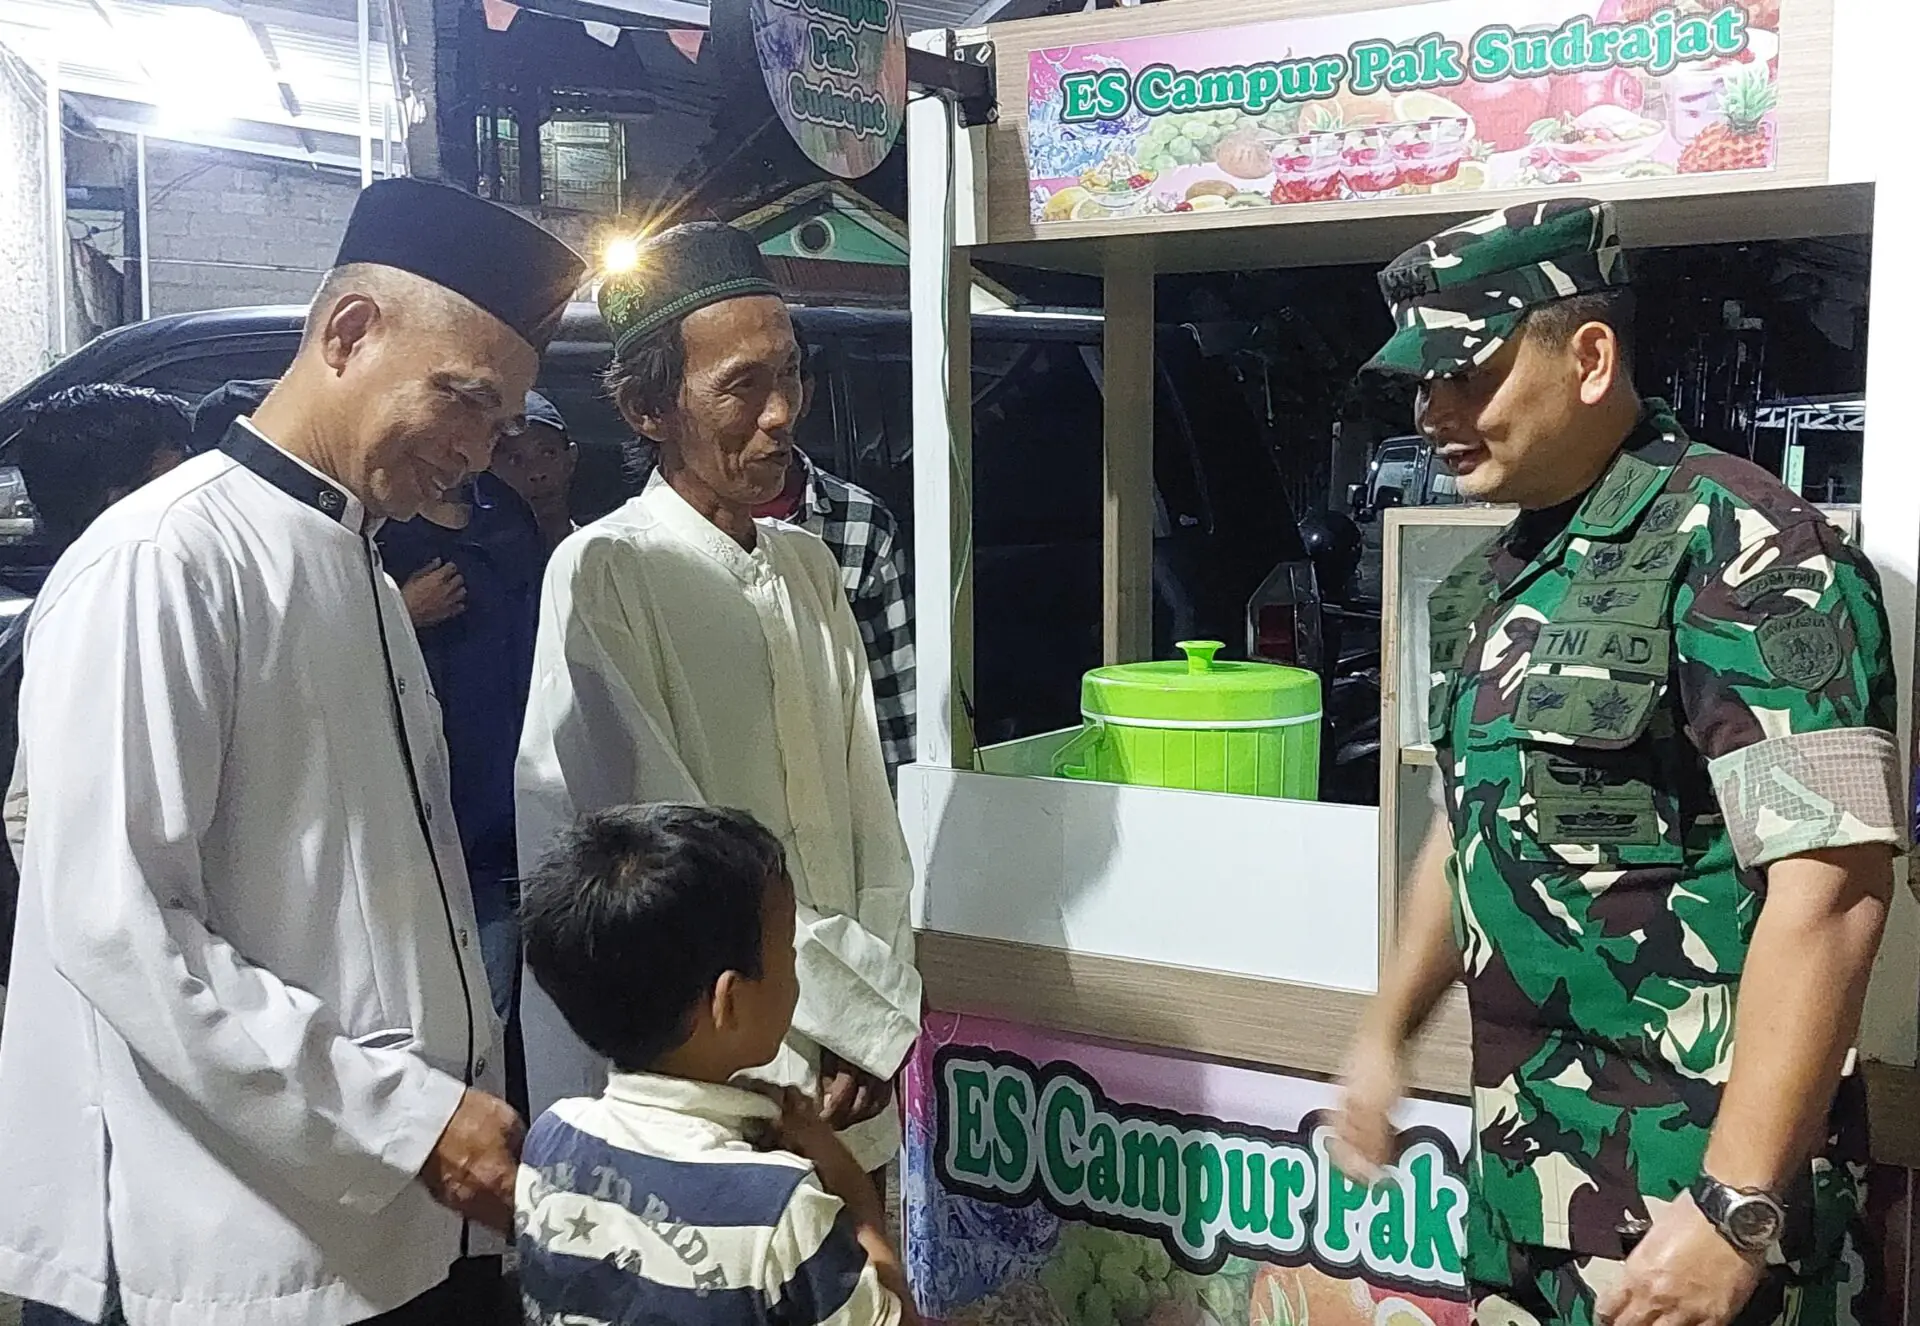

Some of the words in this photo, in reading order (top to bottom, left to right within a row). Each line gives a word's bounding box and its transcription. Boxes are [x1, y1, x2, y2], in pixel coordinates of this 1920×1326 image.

[804, 0, 887, 28] mpur
[811, 26, 858, 74] Pak
[1062, 73, 1130, 119] ES
[1136, 56, 1342, 113] Campur
[1353, 35, 1464, 89] Pak
[1473, 4, 1746, 76] Sudrajat
[1545, 629, 1589, 656] TNI
[1596, 631, 1653, 665] AD
[948, 1064, 1032, 1188] ES
[1041, 1083, 1306, 1249] Campur
[1326, 1132, 1464, 1275] Pak
